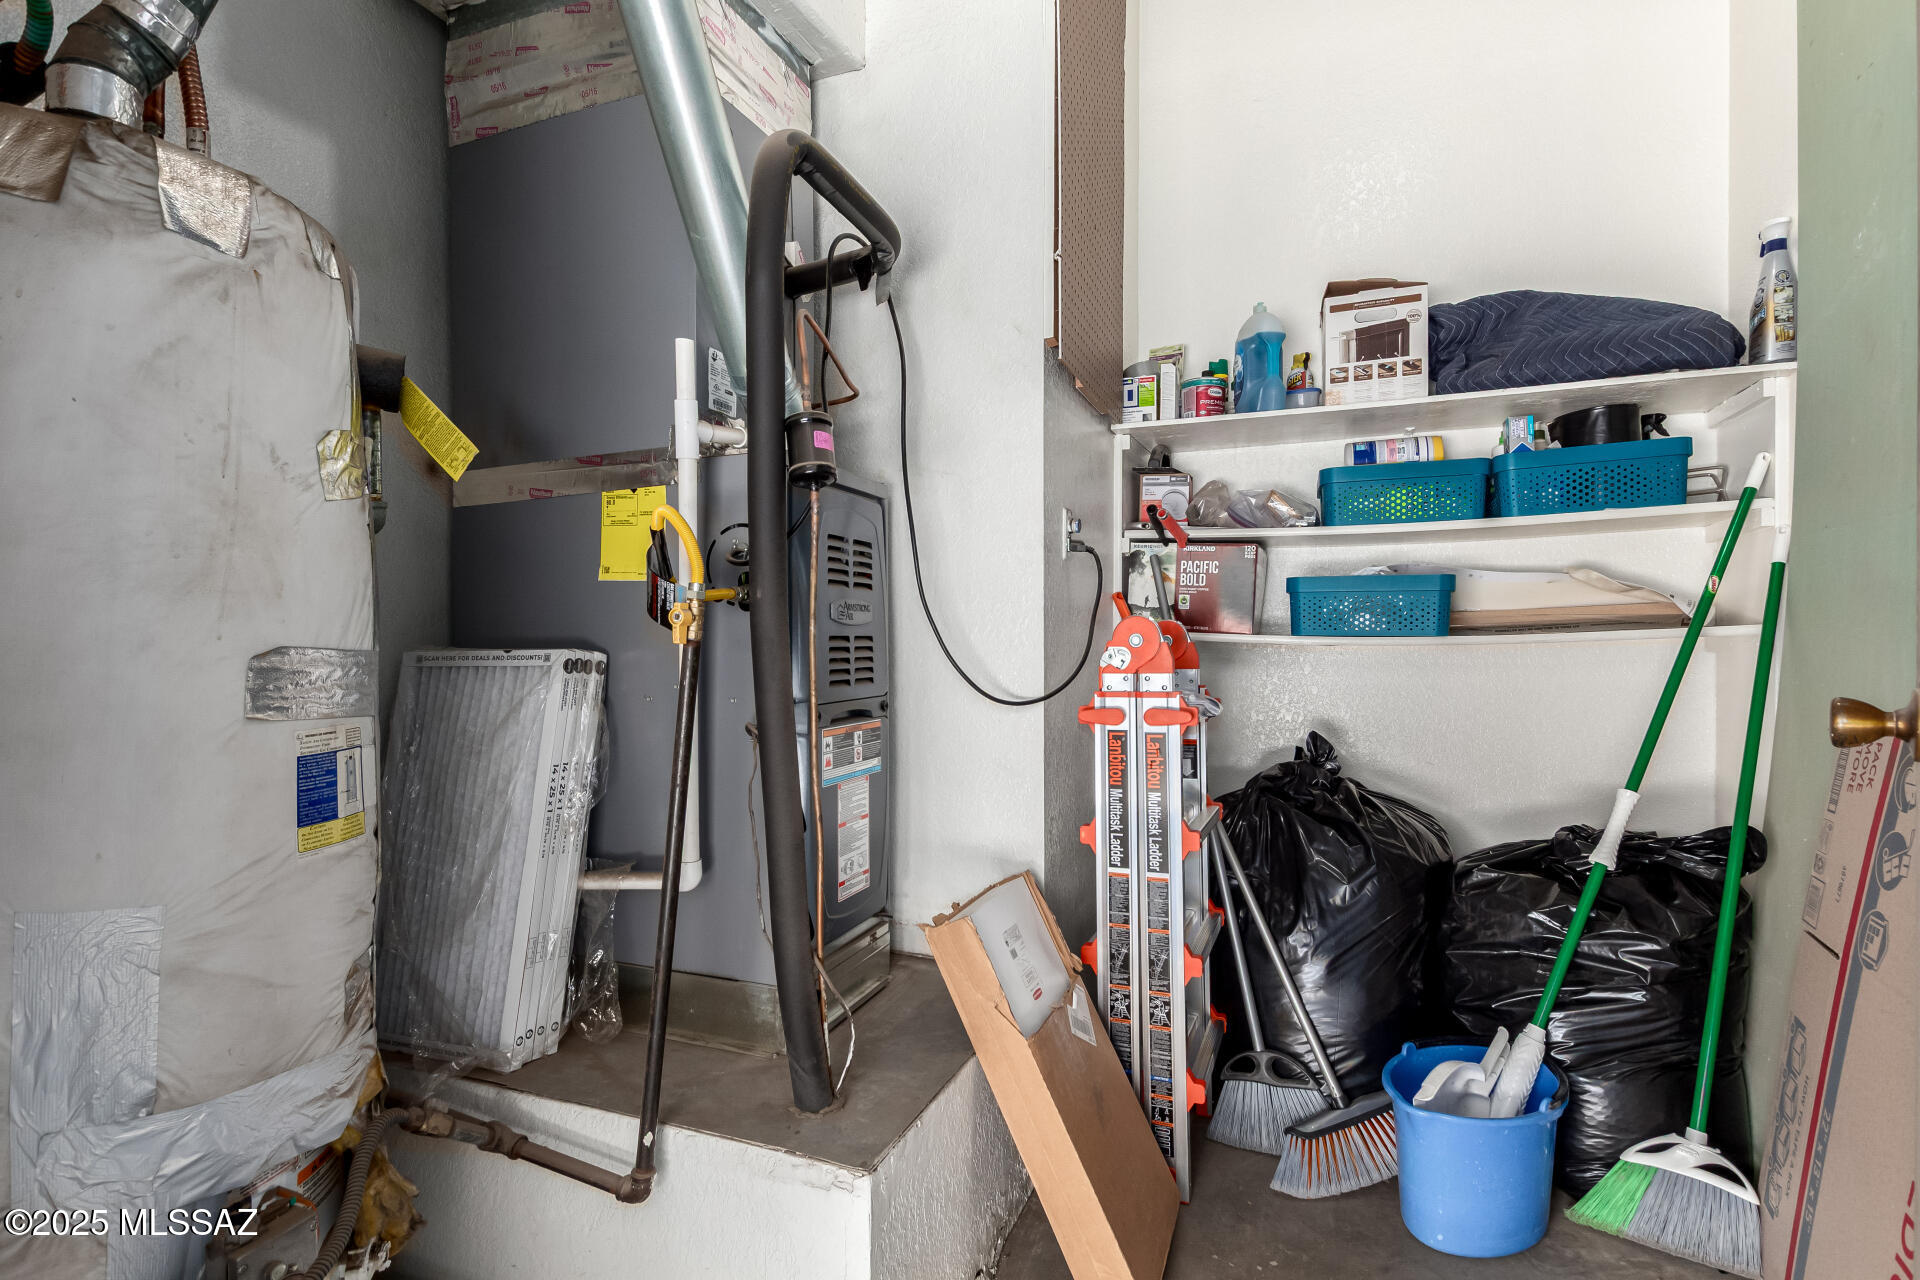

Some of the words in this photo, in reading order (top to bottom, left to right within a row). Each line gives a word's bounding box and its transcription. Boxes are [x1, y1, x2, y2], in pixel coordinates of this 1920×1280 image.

[1180, 561, 1219, 573] PACIFIC
[1180, 574, 1206, 586] BOLD
[553, 764, 559, 774] 14
[563, 762, 568, 773] 14
[1109, 732, 1126, 785] Lanbitou
[1146, 734, 1164, 788] Lanbitou
[1846, 748, 1863, 793] TORE
[1856, 742, 1873, 792] MOVE
[1866, 742, 1883, 789] PACK
[550, 786, 556, 798] 25
[559, 784, 565, 796] 25
[1110, 788, 1123, 830] Multitask
[1148, 792, 1162, 835] Multitask
[1110, 833, 1123, 866] Ladder
[1149, 838, 1162, 871] Ladder
[1801, 1075, 1810, 1106] HOW
